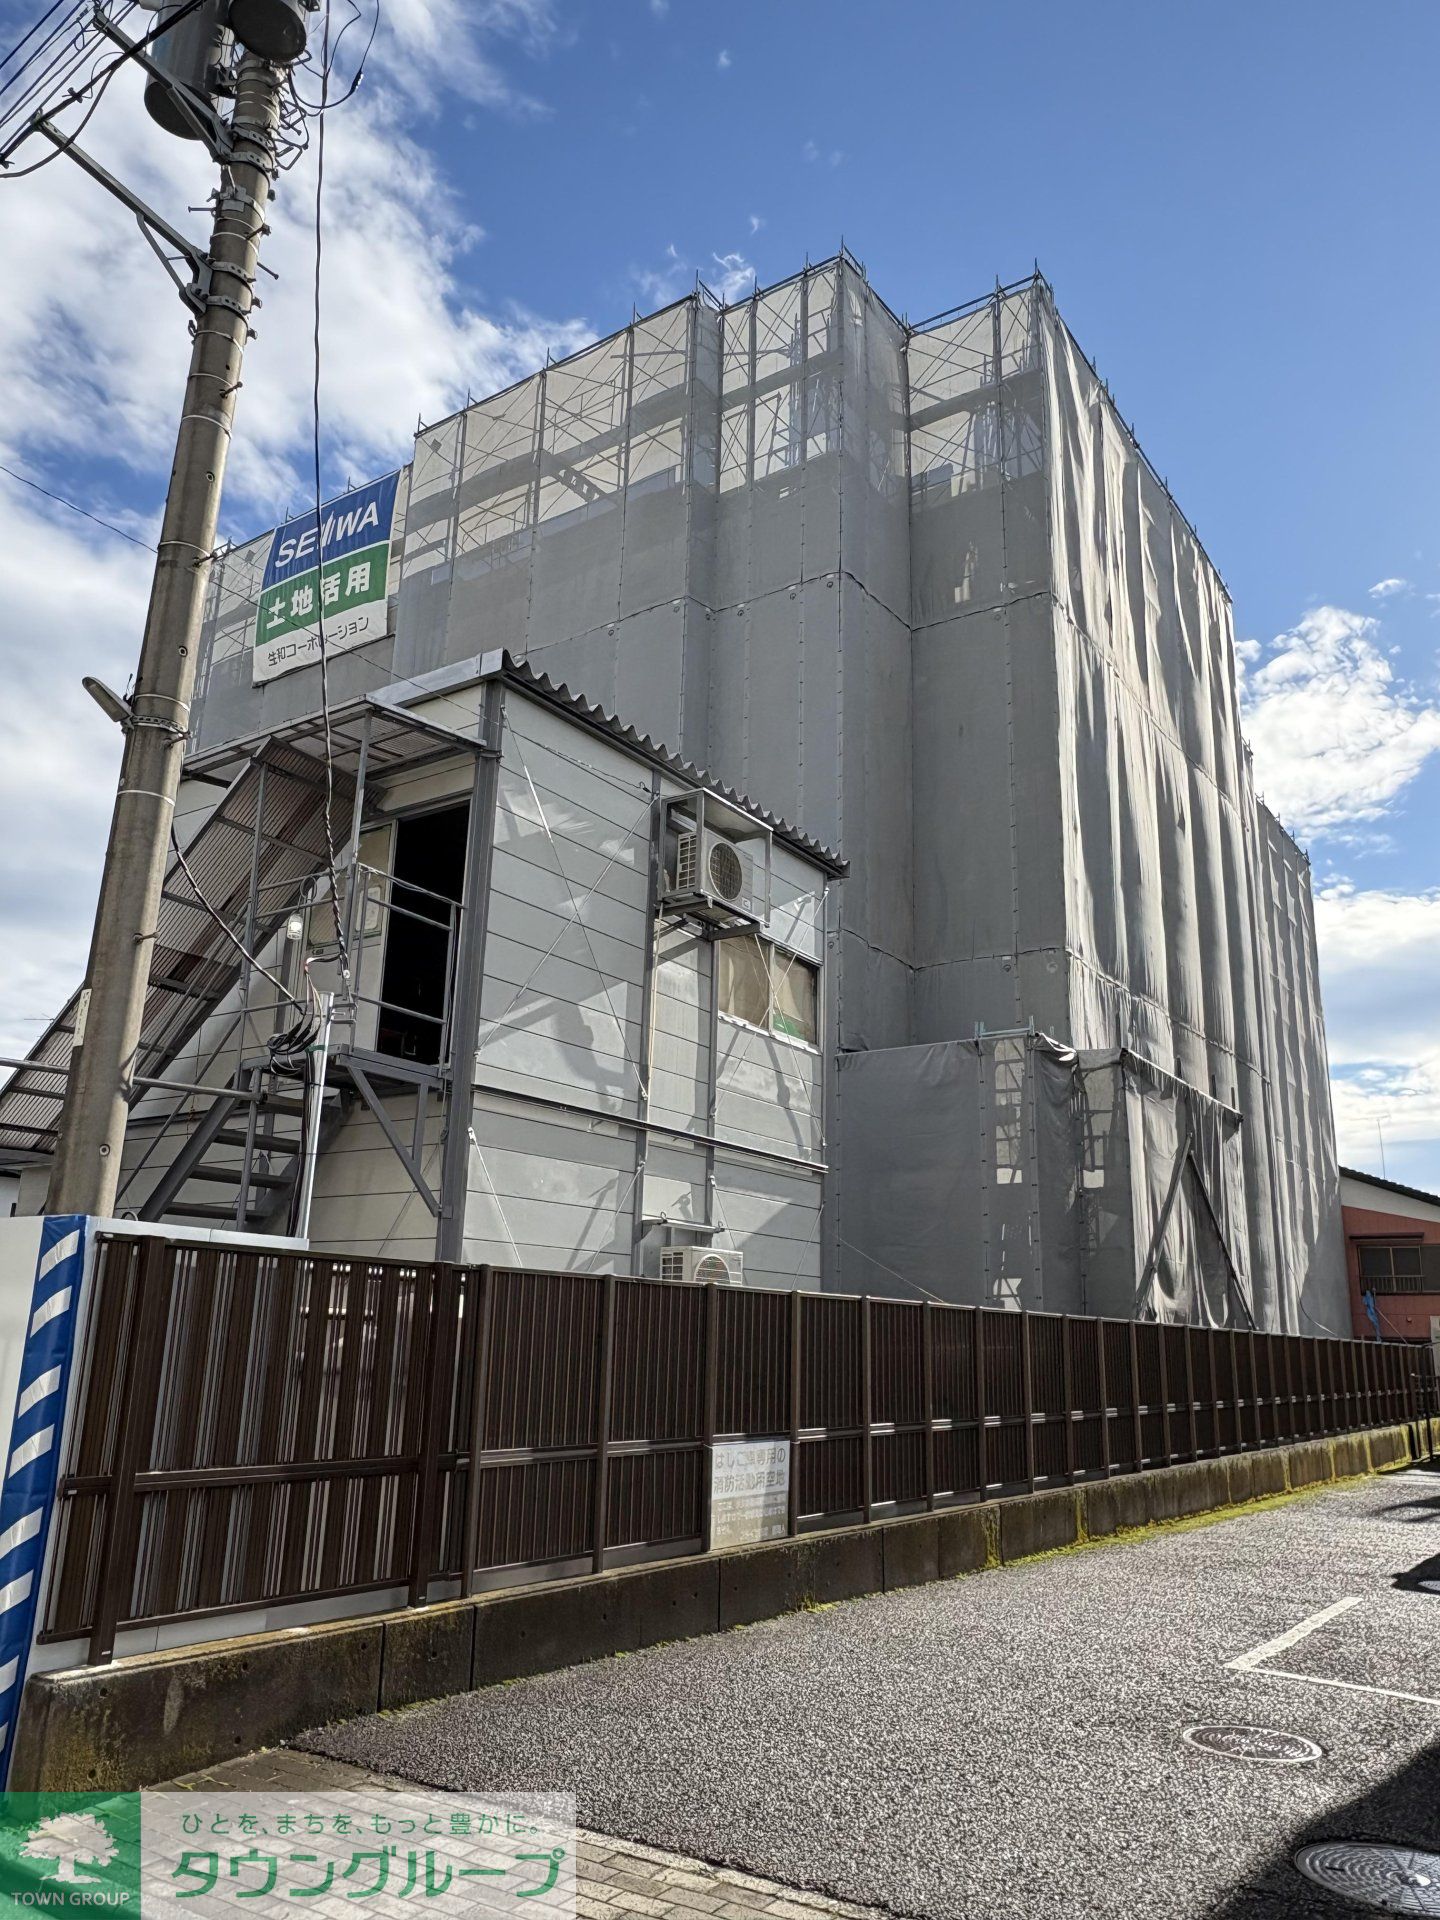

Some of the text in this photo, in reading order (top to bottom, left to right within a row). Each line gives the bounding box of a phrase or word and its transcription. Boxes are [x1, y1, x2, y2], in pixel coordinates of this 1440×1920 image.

[275, 501, 379, 568] SEIWA
[266, 562, 371, 630] 土地活用
